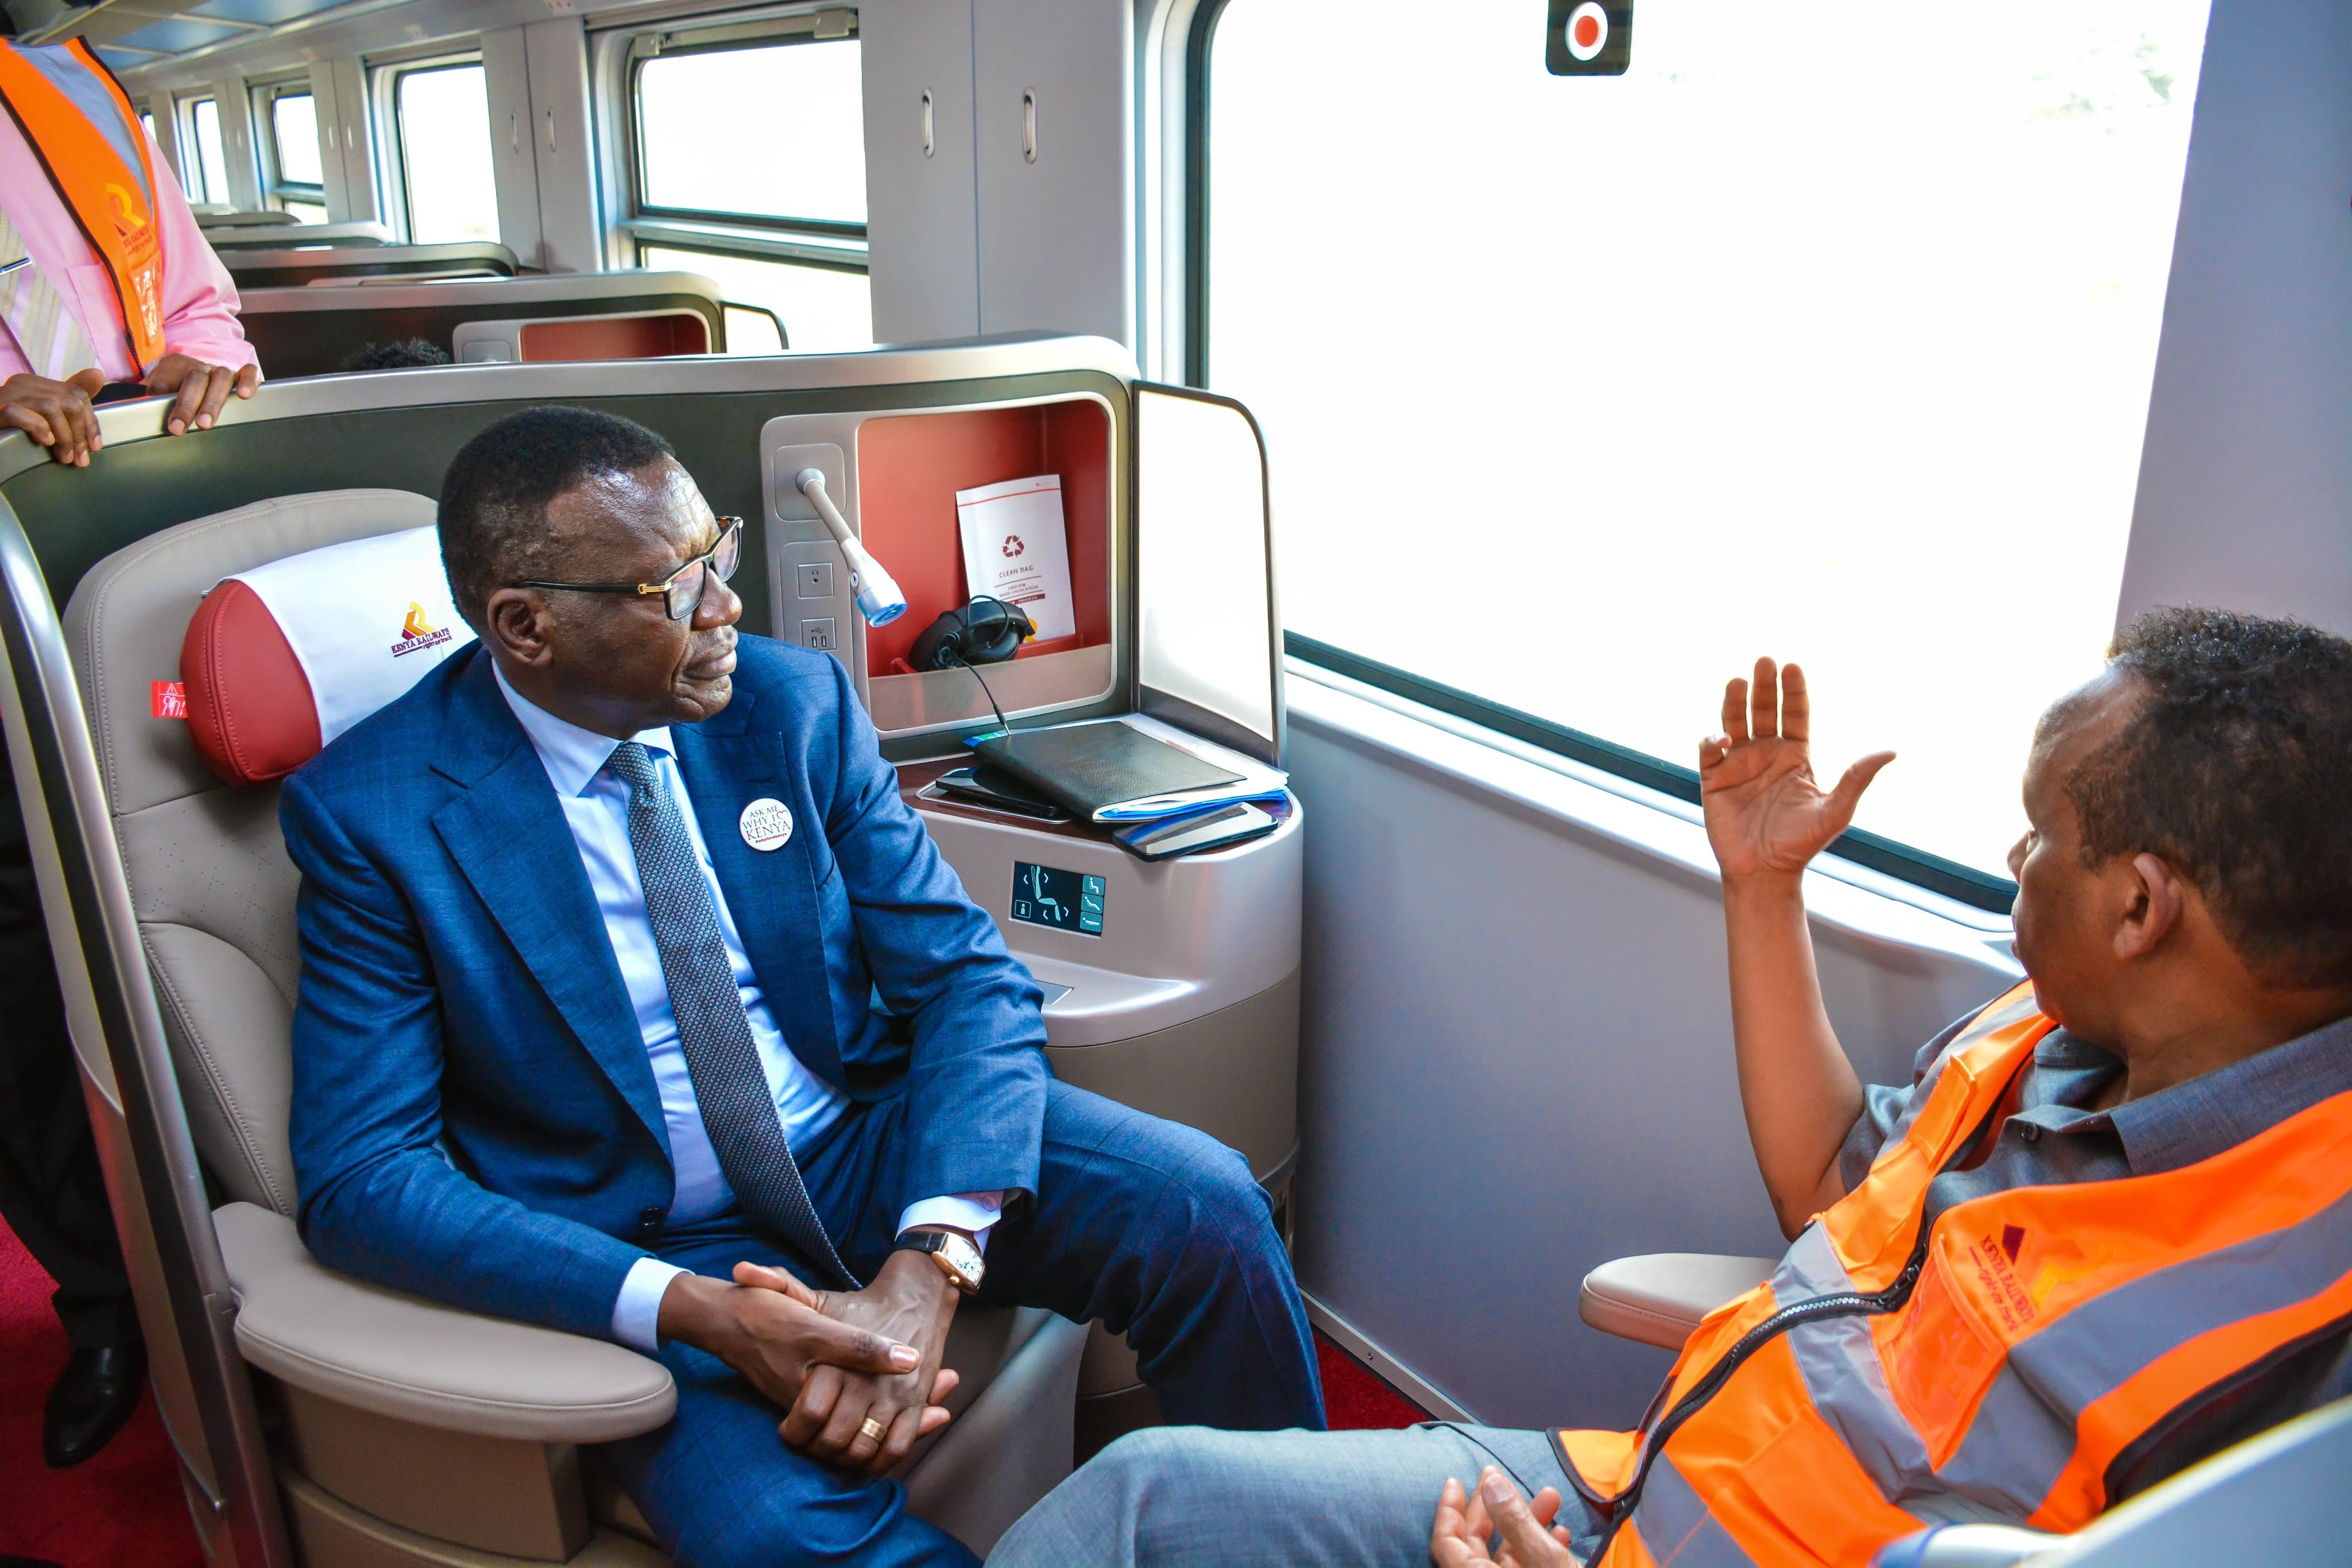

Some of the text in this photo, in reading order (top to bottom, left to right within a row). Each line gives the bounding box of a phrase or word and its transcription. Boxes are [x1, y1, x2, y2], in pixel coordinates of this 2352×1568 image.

[999, 565, 1033, 578] CLEAN BAG
[391, 628, 450, 653] KENYA RAILWAYS
[441, 635, 452, 643] track
[750, 805, 779, 819] ASK ME
[742, 816, 768, 829] WHY
[746, 821, 791, 841] KENYA
[1980, 1234, 2035, 1324] KENYA RAILWAYS
